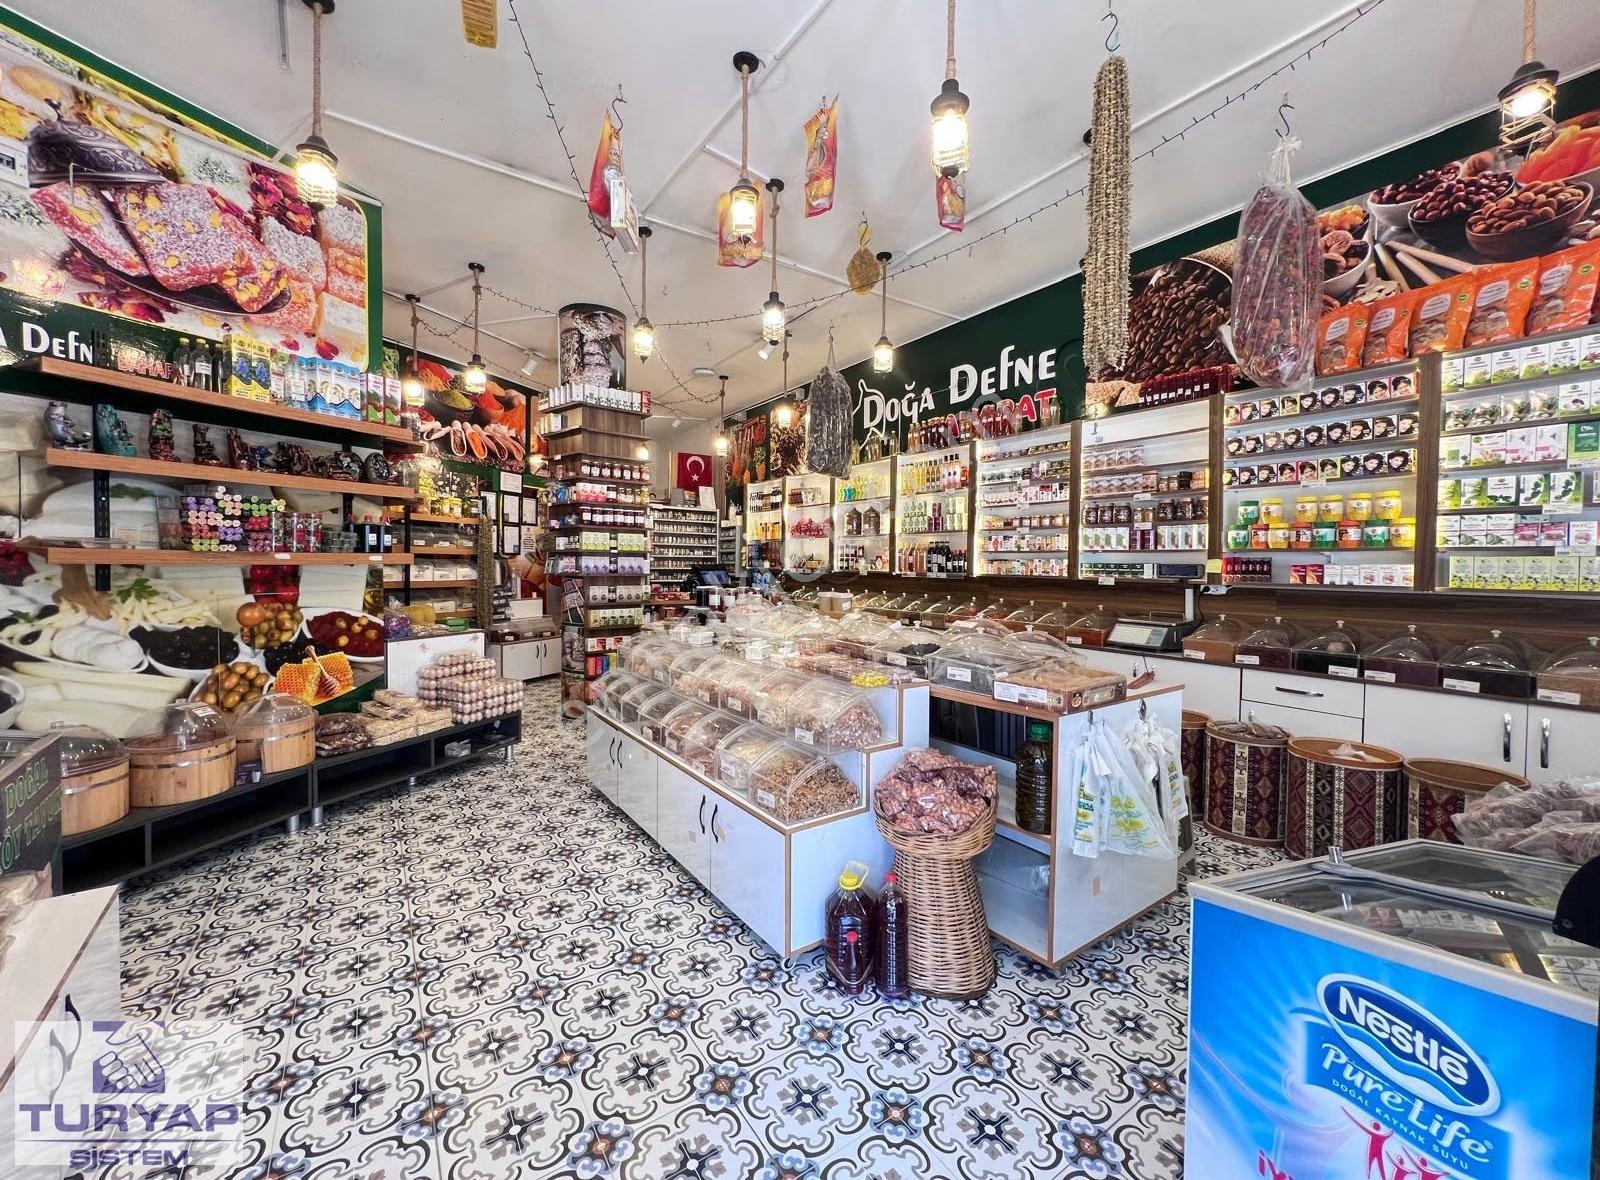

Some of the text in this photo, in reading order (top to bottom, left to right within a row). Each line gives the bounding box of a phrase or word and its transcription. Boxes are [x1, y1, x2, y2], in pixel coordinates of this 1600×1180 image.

[0, 824, 22, 875] ÖY
[1375, 1107, 1425, 1144] KAYNAK
[1432, 1143, 1469, 1169] SUYU
